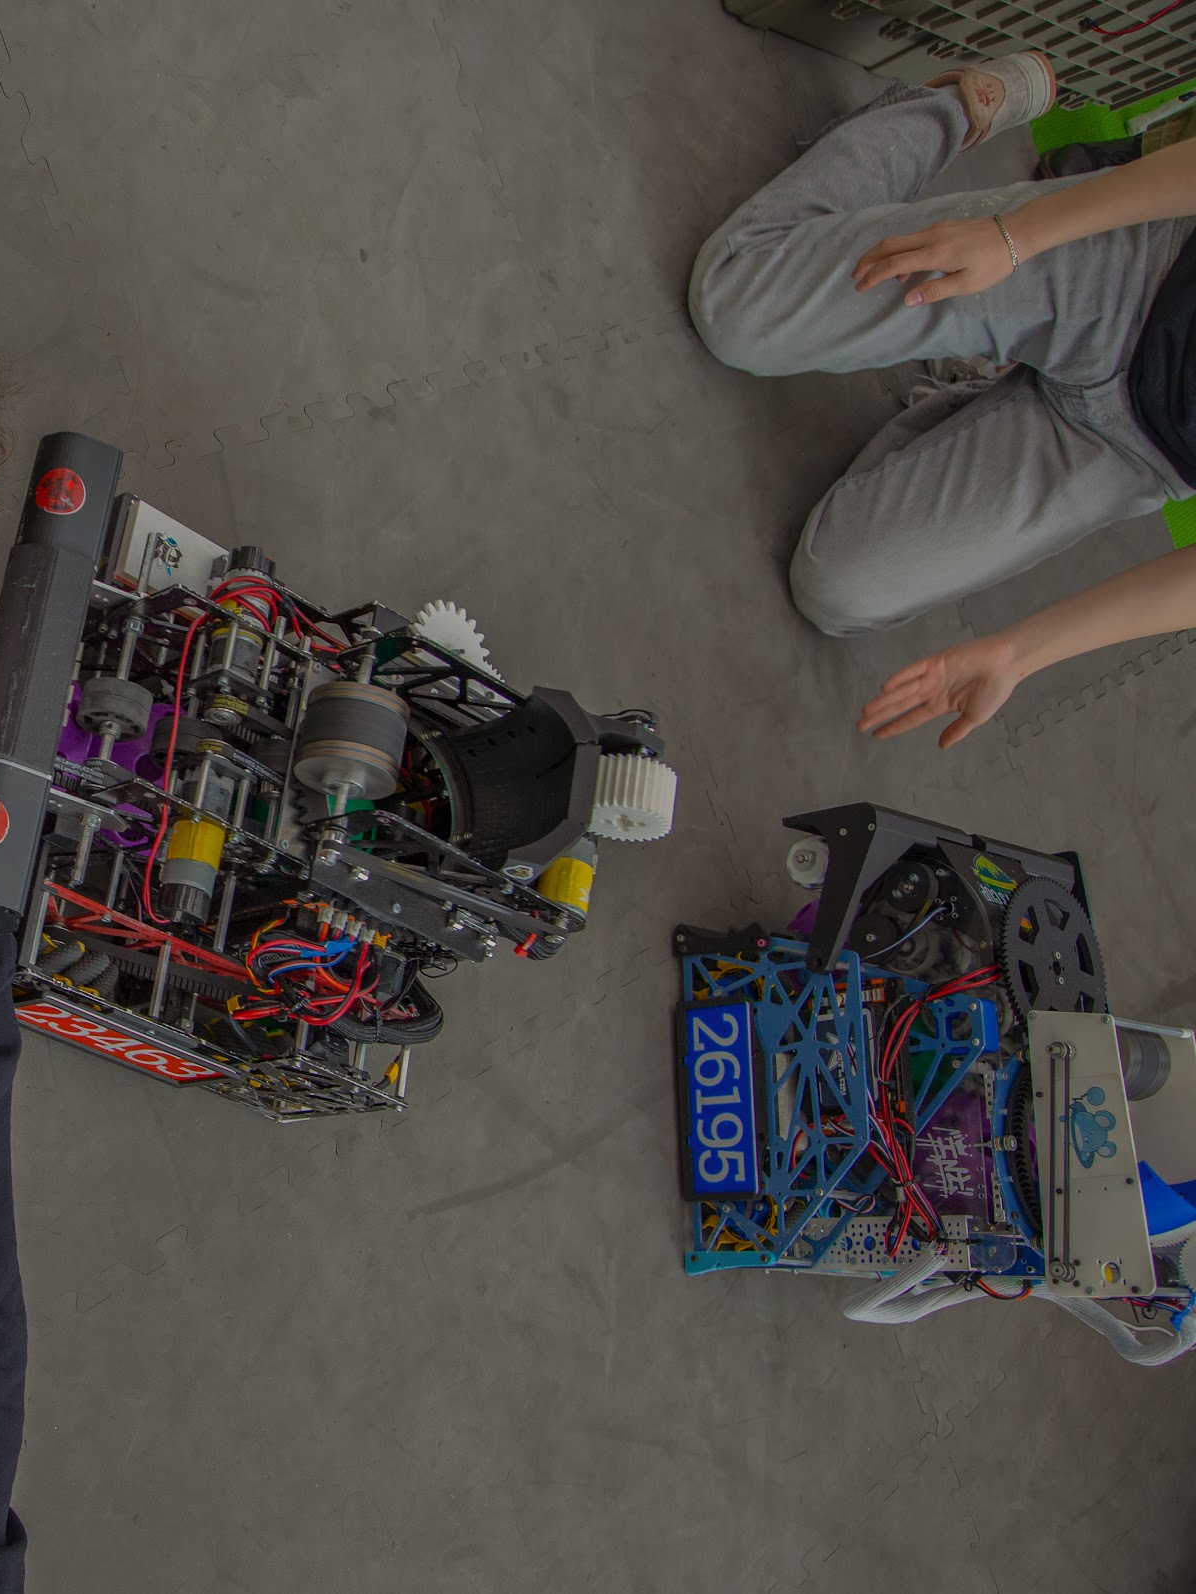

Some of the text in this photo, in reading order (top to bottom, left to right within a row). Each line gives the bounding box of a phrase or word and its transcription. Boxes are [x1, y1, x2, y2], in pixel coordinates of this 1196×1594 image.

[15, 1002, 216, 1079] 23463
[836, 1050, 847, 1096] ATURN
[692, 1013, 746, 1183] 26195
